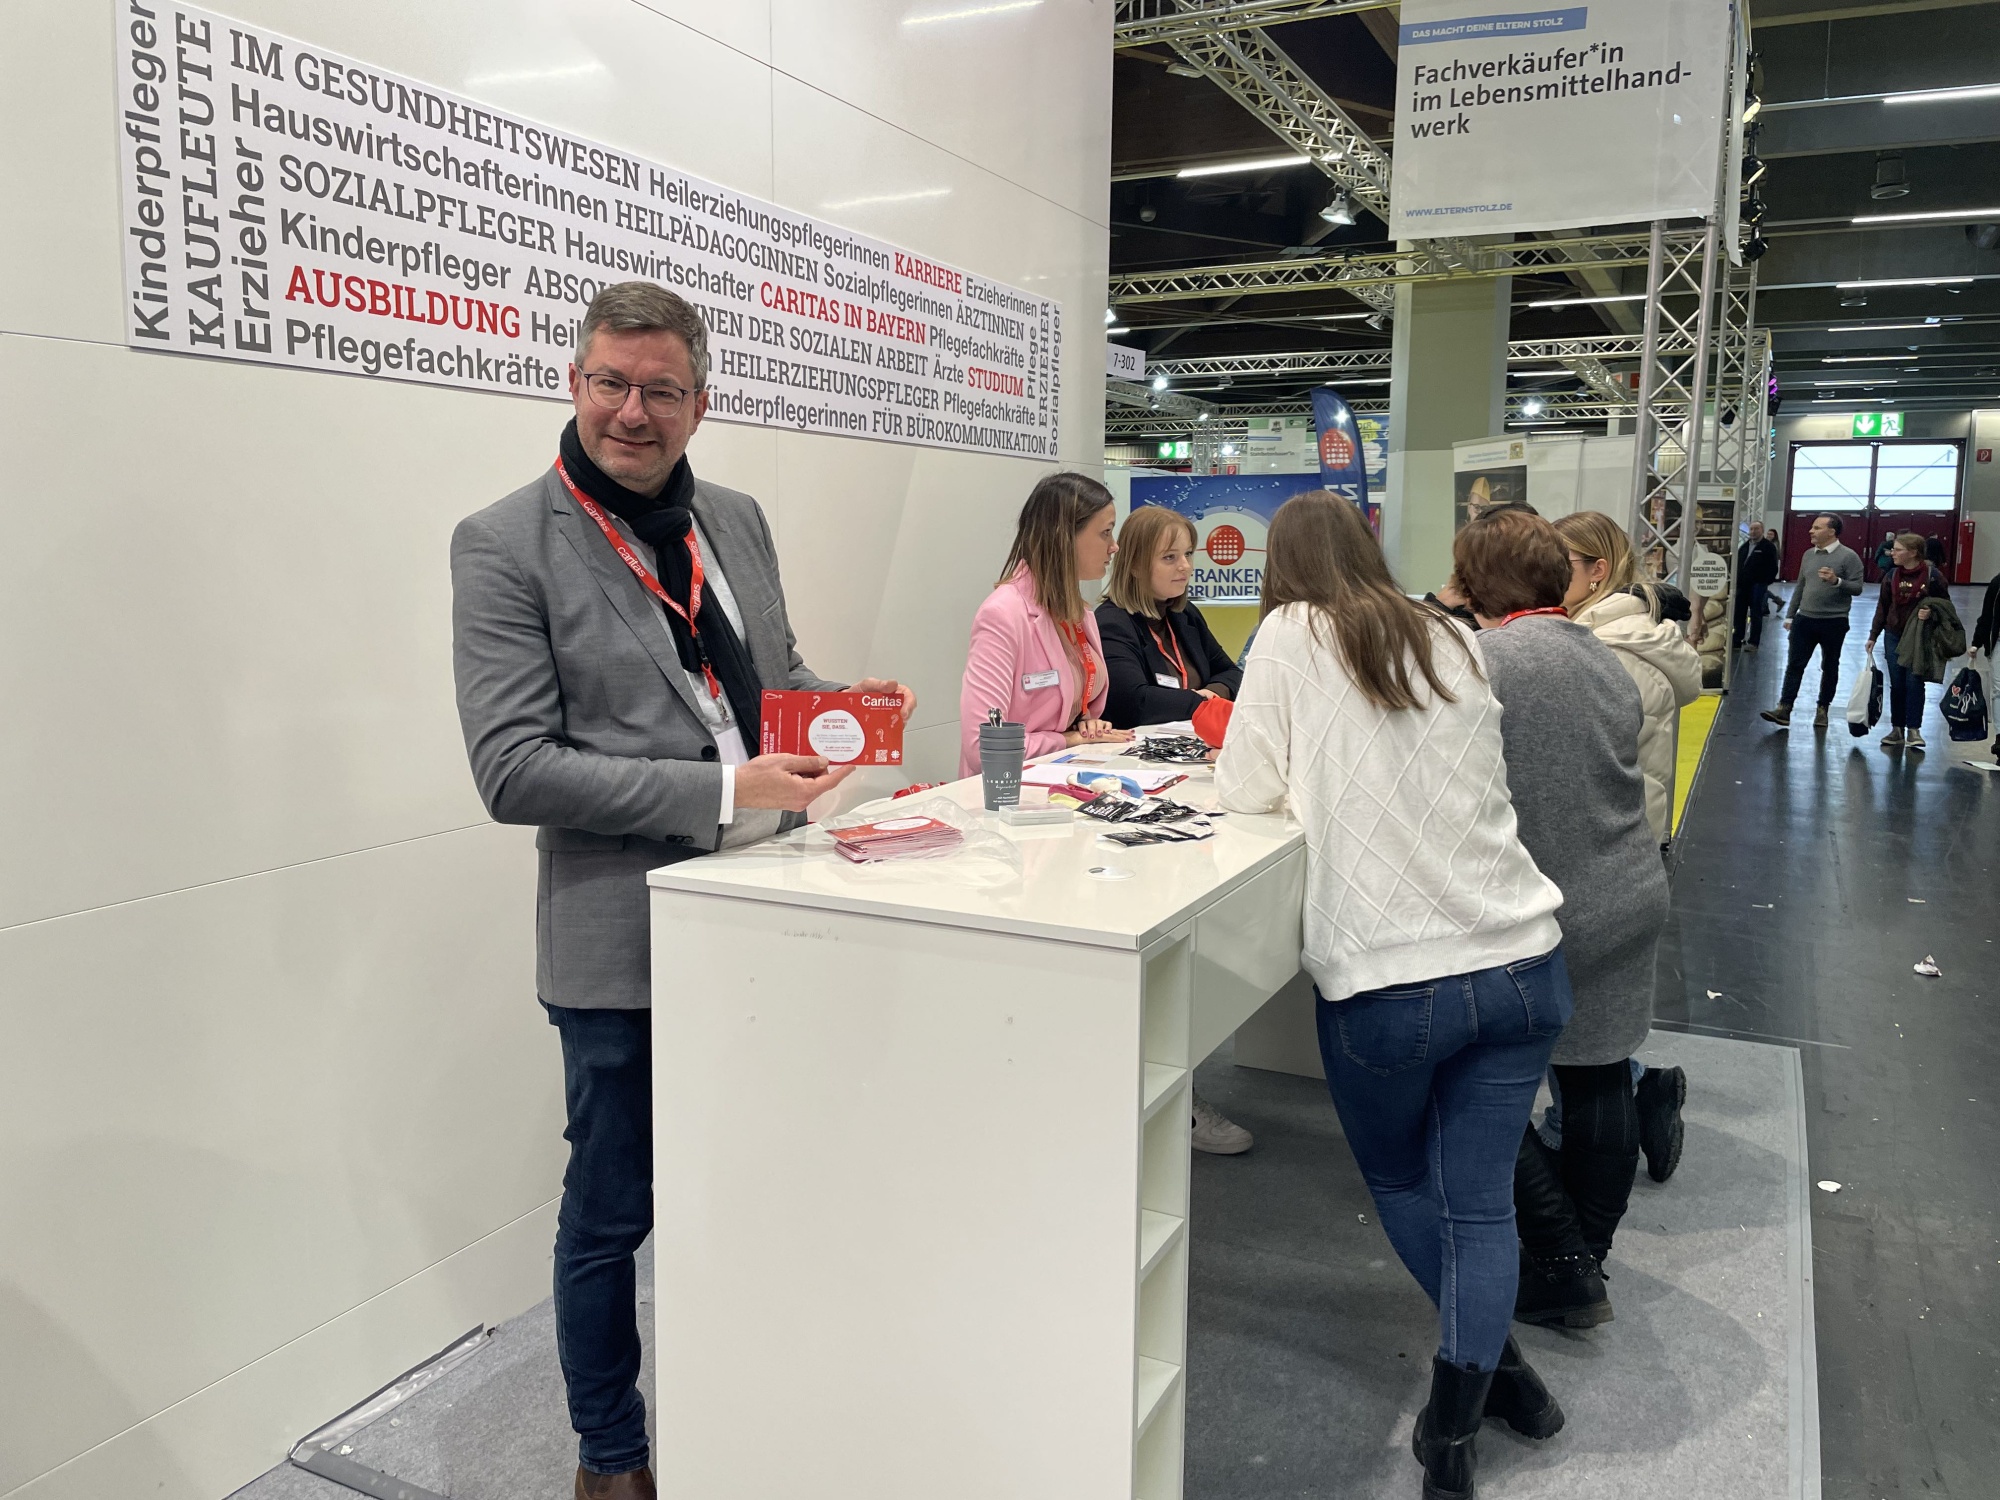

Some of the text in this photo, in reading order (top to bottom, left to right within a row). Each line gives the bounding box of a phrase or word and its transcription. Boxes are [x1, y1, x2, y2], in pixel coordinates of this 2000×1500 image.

[1412, 17, 1564, 39] DAS MACHT DEINE ELTERN STOLZ
[1412, 61, 1692, 112] im Lebensmittelhand-
[1411, 113, 1470, 139] werk
[124, 0, 170, 341] Kinderpfleger
[175, 12, 225, 349] KAUFLEUTE
[229, 28, 1038, 318] IM GESUNDHEITSWESEN Heilerziehungspflegerinnen KARRIERE Erzieherinnen
[229, 137, 272, 354] Erzieher
[231, 83, 1025, 341] Hauswirtschafterinnen HEILPÄDAGOGINNEN Sozialpflegerinnen ÄRZTINNEN
[1405, 203, 1513, 218] WWW.ELTERNSTOLZ.DE
[279, 154, 1025, 369] SOZIALPFLEGER Hauswirtschafter CARITAS IN BAYERN Pflegefachkräfte
[280, 208, 511, 290] Kinderpfleger
[748, 314, 785, 348] DER
[790, 326, 872, 367] SOZIALEN
[876, 347, 928, 377] ARBEIT
[933, 358, 964, 386] Ärzte
[968, 366, 1024, 398] STUDIUM
[285, 265, 521, 338] AUSBILDUNG
[286, 318, 560, 390] Pflegefachkräfte
[720, 349, 1036, 427] HEILERZIEHUNGSPFLEGER Pflegefachkräfte
[1027, 326, 1039, 399] Pflege
[1039, 302, 1050, 428] ERZIEHER
[1050, 305, 1061, 456] Sozialpfleger
[1113, 353, 1135, 371] 7-302
[872, 406, 903, 436] FÜR
[907, 411, 1046, 455] BÜROKOMMUNIKATION
[1191, 568, 1264, 583] RANKEN
[862, 695, 902, 707] Caritas
